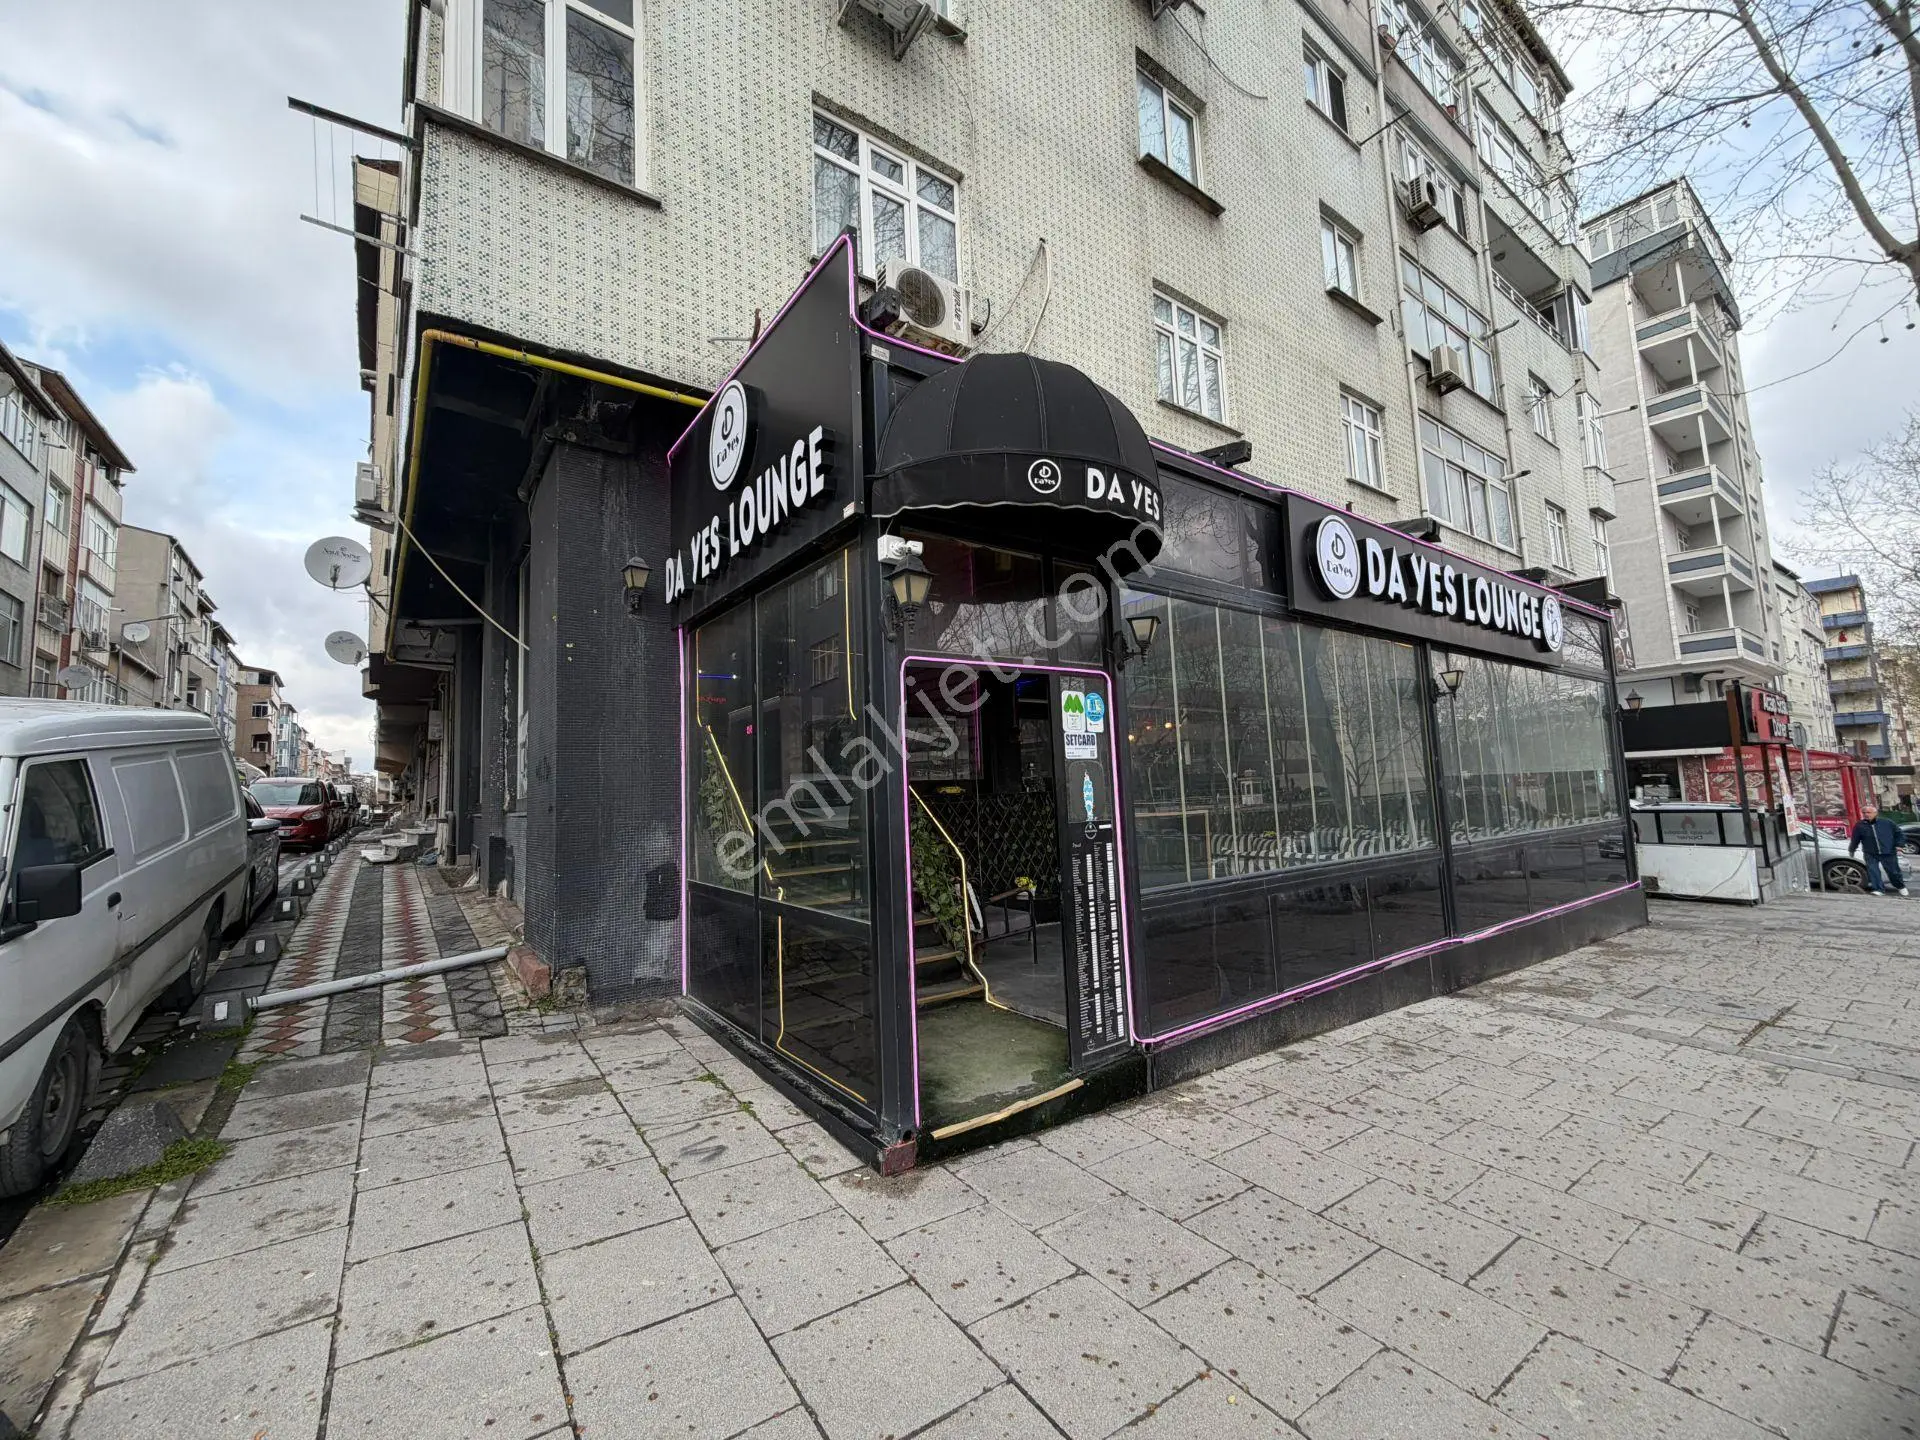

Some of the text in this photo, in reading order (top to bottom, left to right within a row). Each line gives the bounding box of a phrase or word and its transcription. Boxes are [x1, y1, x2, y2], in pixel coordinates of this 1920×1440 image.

[665, 424, 825, 604] DA YES LOUNGE
[1087, 467, 1160, 521] DA YES
[1365, 537, 1543, 639] DA YES LOUNGE
[1065, 733, 1096, 746] SETCARD
